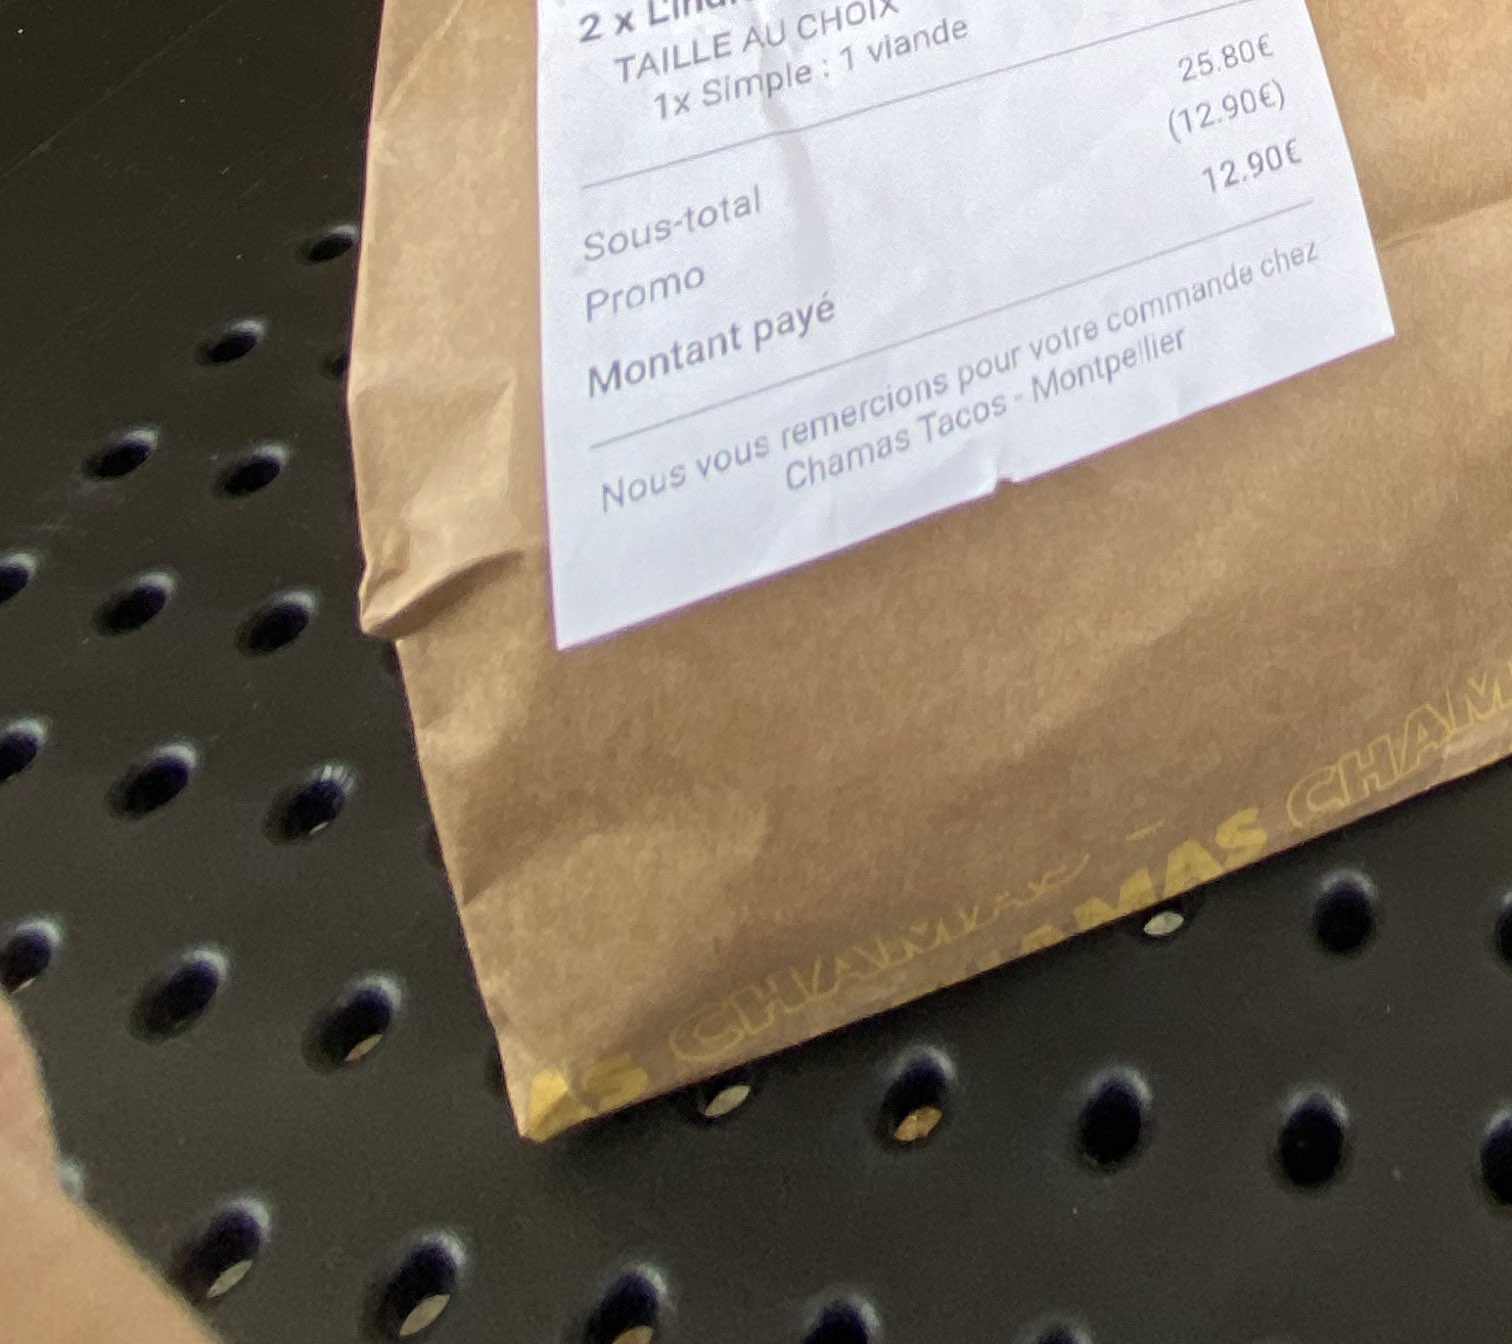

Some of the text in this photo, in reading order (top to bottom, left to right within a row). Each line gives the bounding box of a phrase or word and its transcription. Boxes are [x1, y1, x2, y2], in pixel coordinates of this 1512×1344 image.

[578, 13, 602, 43] 2
[615, 9, 636, 36] x
[614, 31, 733, 84] TAILLE
[742, 19, 786, 53] AU
[1177, 33, 1274, 83] 25.80€
[653, 91, 692, 121] 1x
[701, 60, 814, 108] Simple
[839, 45, 854, 72] 1
[867, 16, 969, 64] viande
[1168, 78, 1285, 144] (12.90€)
[1202, 138, 1302, 194] 12.90€
[582, 183, 761, 263] Sous-total
[585, 266, 706, 323] Promo
[587, 290, 836, 399] Montant payé
[600, 240, 1320, 513] Nous vous remercions pour votre commande chez
[785, 428, 911, 492] Chamas
[916, 391, 1007, 444] Tacos
[1030, 327, 1186, 404] Montpellier
